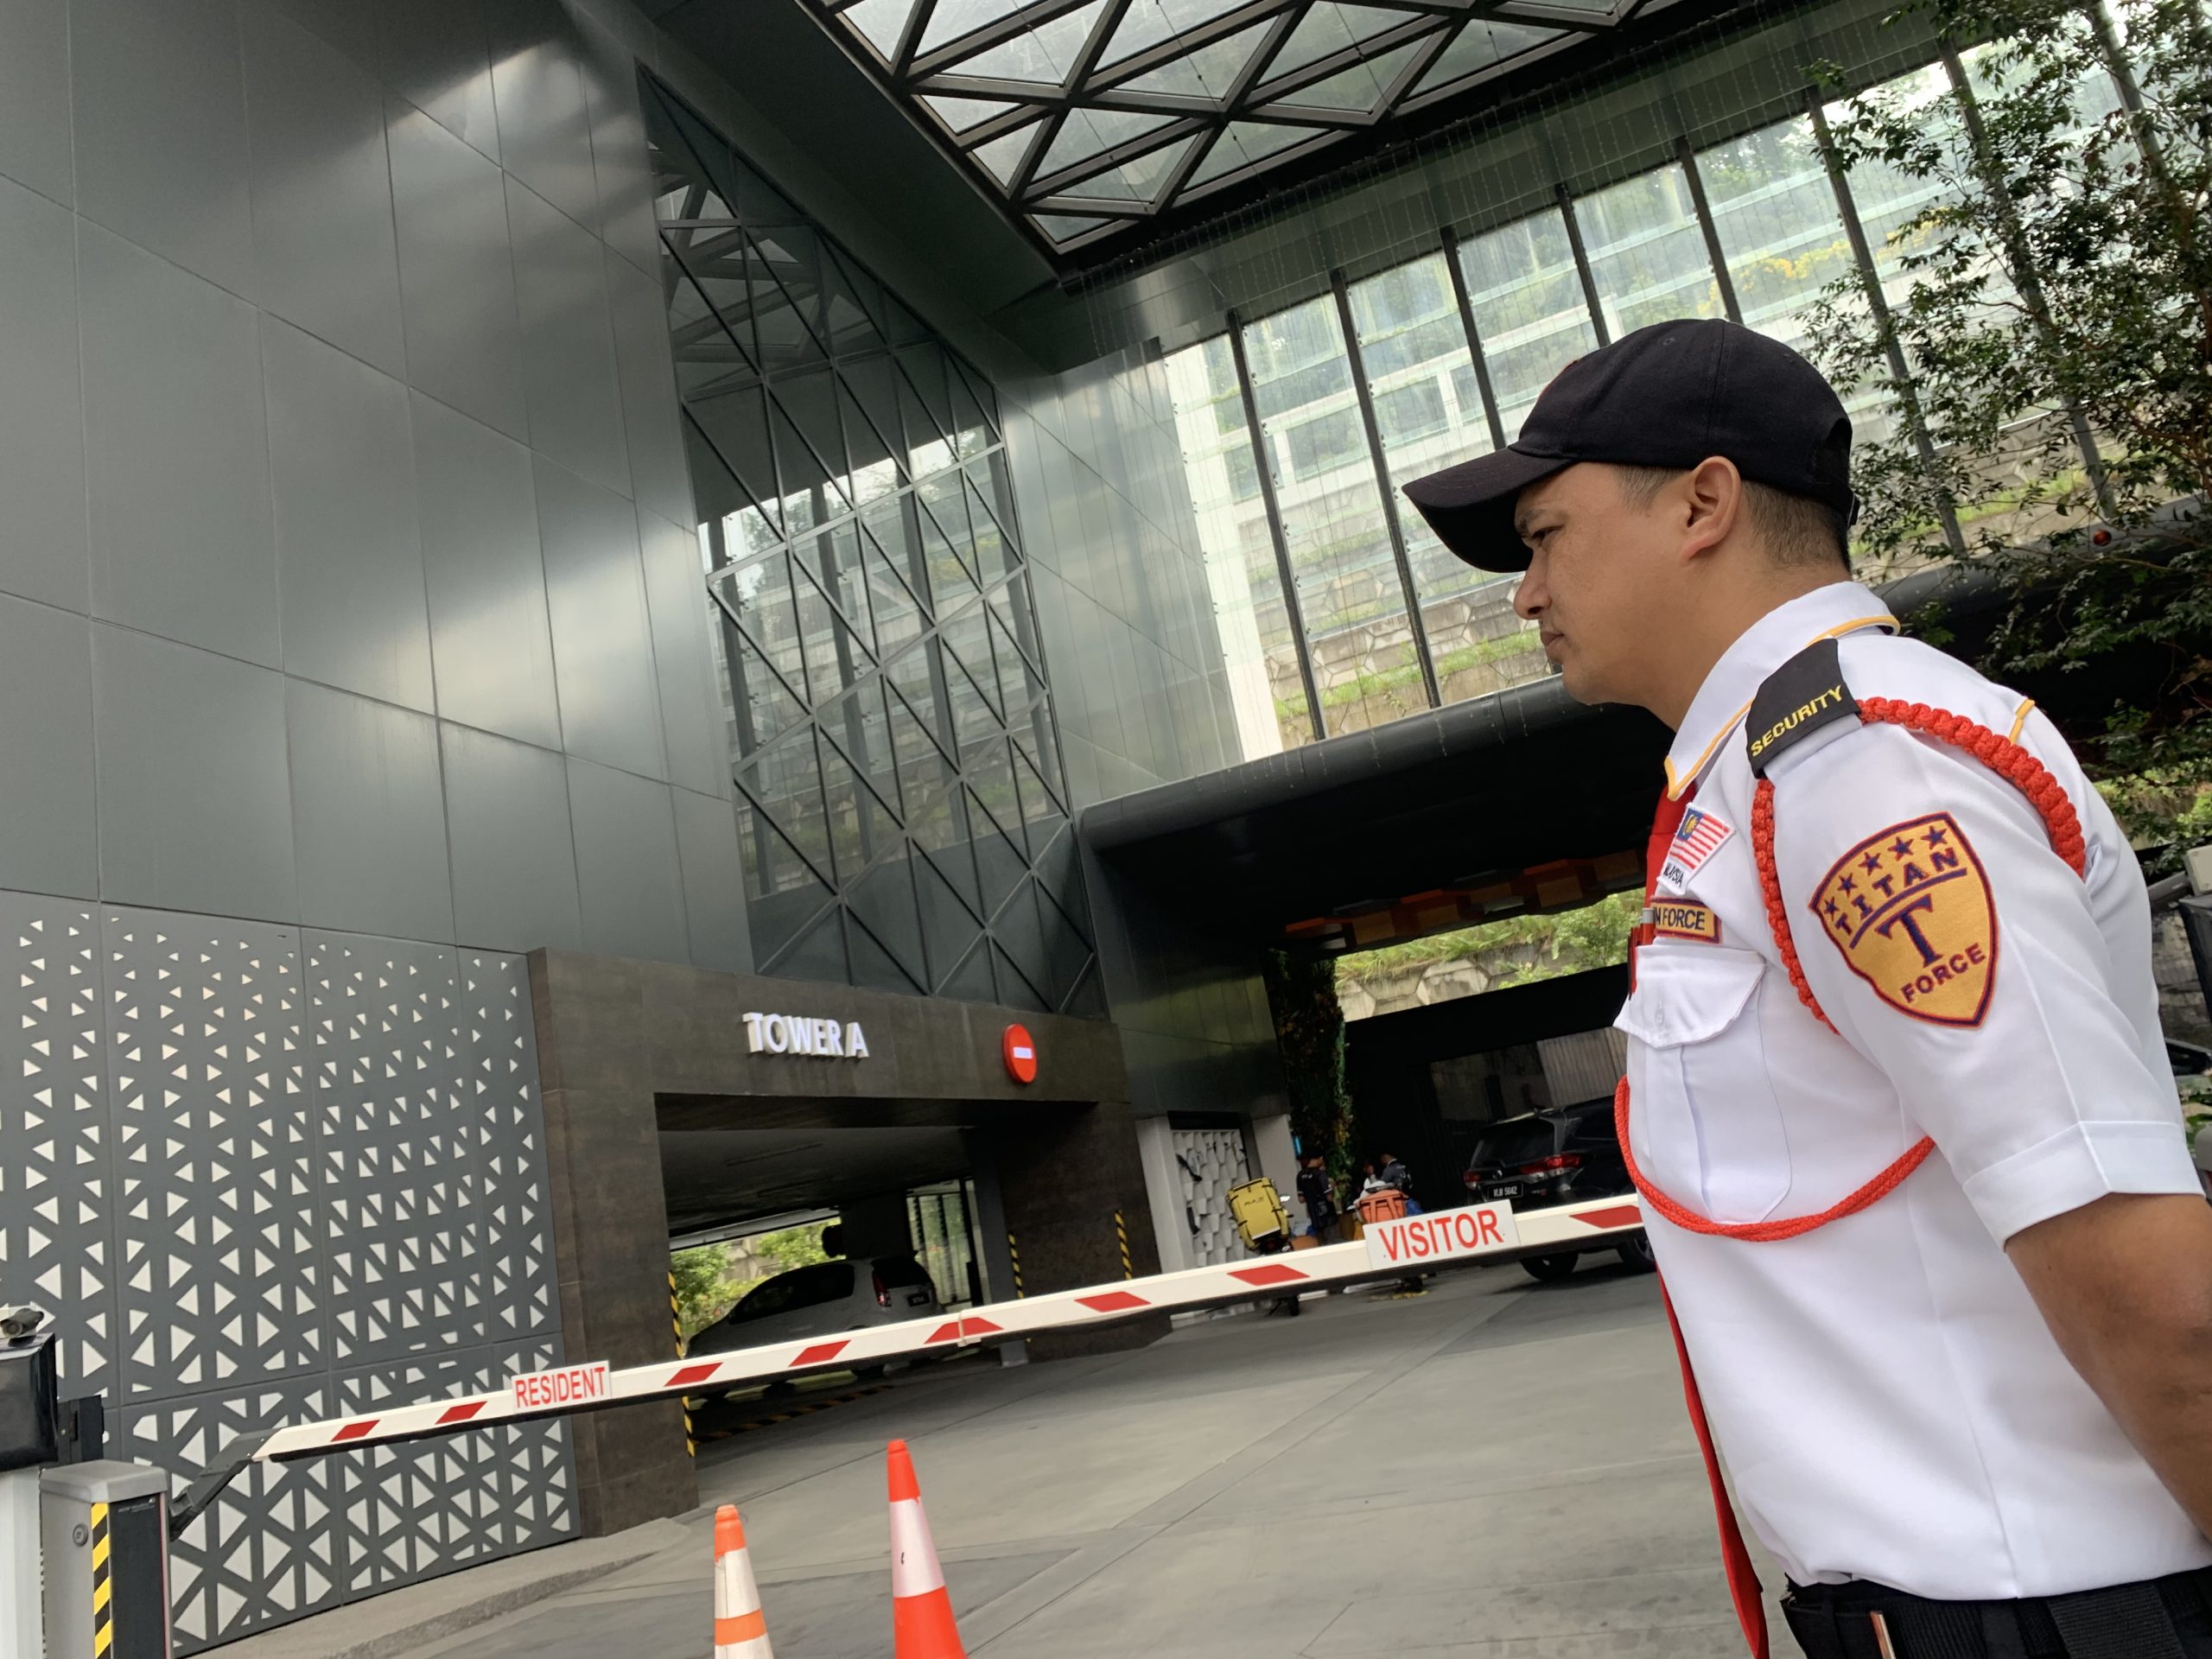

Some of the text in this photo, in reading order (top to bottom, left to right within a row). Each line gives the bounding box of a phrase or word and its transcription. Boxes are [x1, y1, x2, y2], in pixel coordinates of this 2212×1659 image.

[1751, 684, 1842, 757] SECURITY
[1662, 907, 1706, 931] FORCE
[1834, 847, 1960, 936] TITAN
[1874, 893, 1943, 969] T
[1901, 942, 1986, 1003] FORCE
[742, 1012, 869, 1058] TOWER A
[1378, 1210, 1504, 1261] VISITOR
[514, 1367, 605, 1408] RESIDENT
